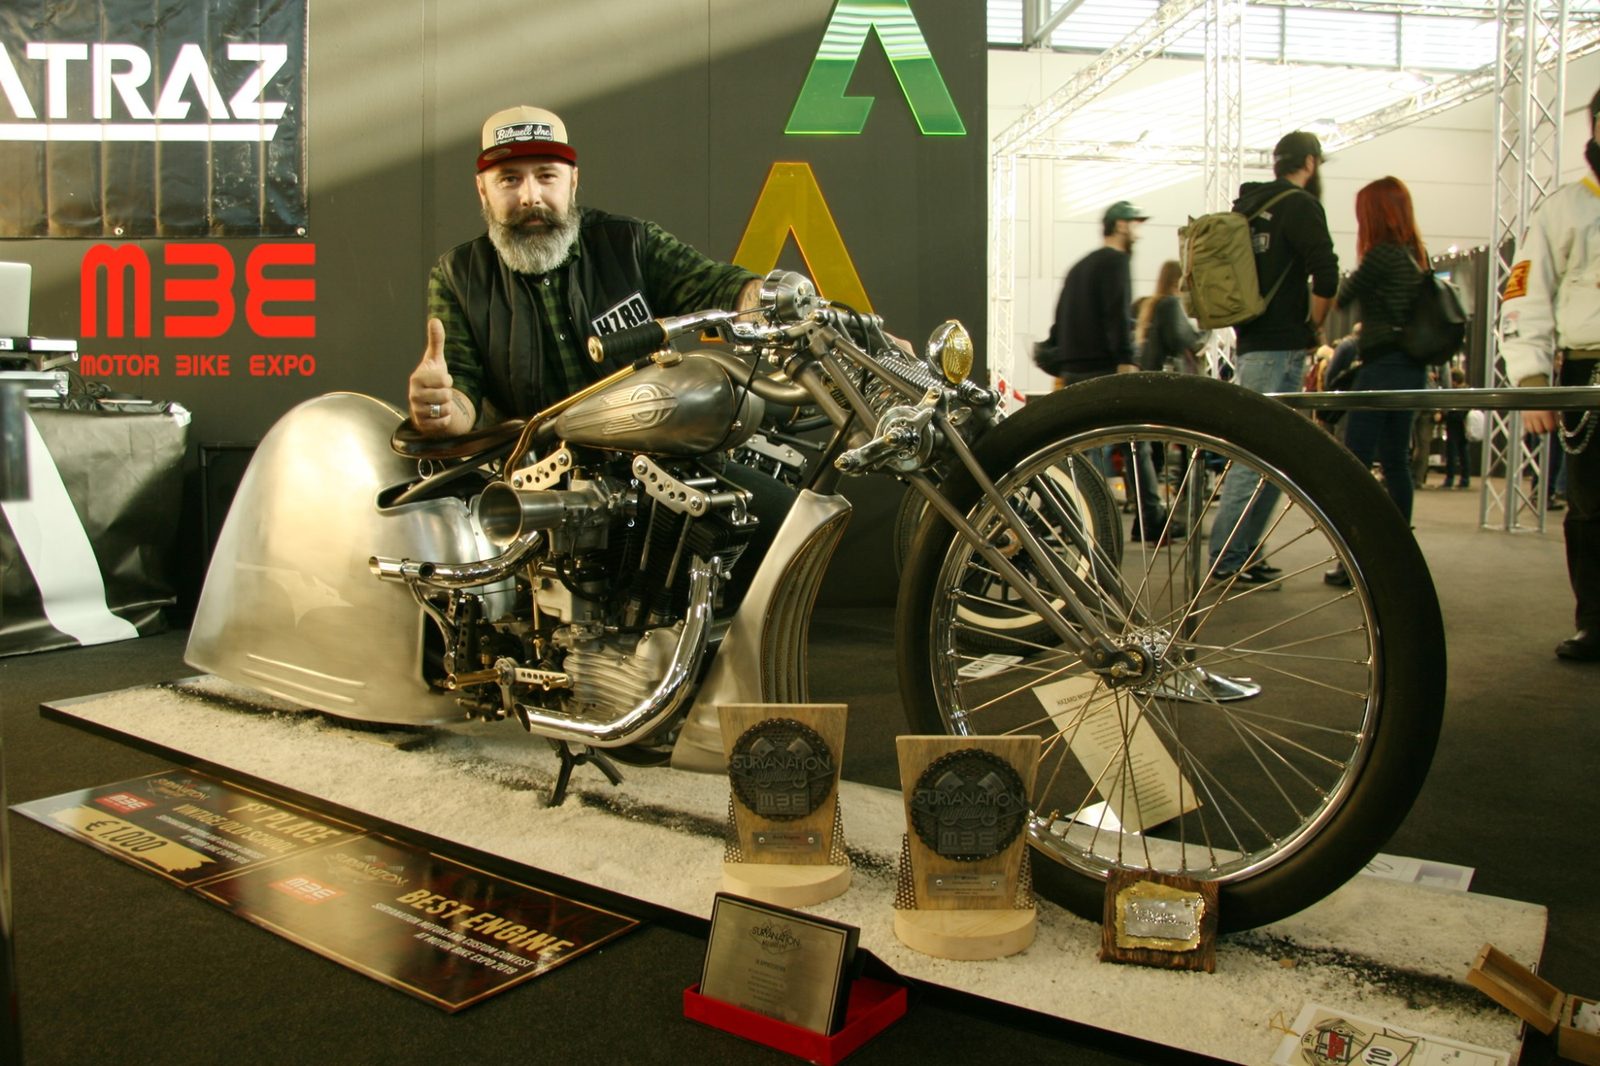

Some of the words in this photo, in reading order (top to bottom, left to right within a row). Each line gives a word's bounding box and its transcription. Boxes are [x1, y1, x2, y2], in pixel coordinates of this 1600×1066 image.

[80, 354, 160, 377] MOTOR
[175, 354, 231, 377] BIKE
[249, 354, 317, 377] EXPO
[733, 756, 831, 770] SURYANATION
[253, 812, 343, 844] PLACE
[395, 889, 475, 919] BEST
[459, 912, 575, 957] ENGINE
[469, 953, 497, 967] EXPO
[491, 962, 519, 976] 2019
[493, 949, 536, 968] CONTEST
